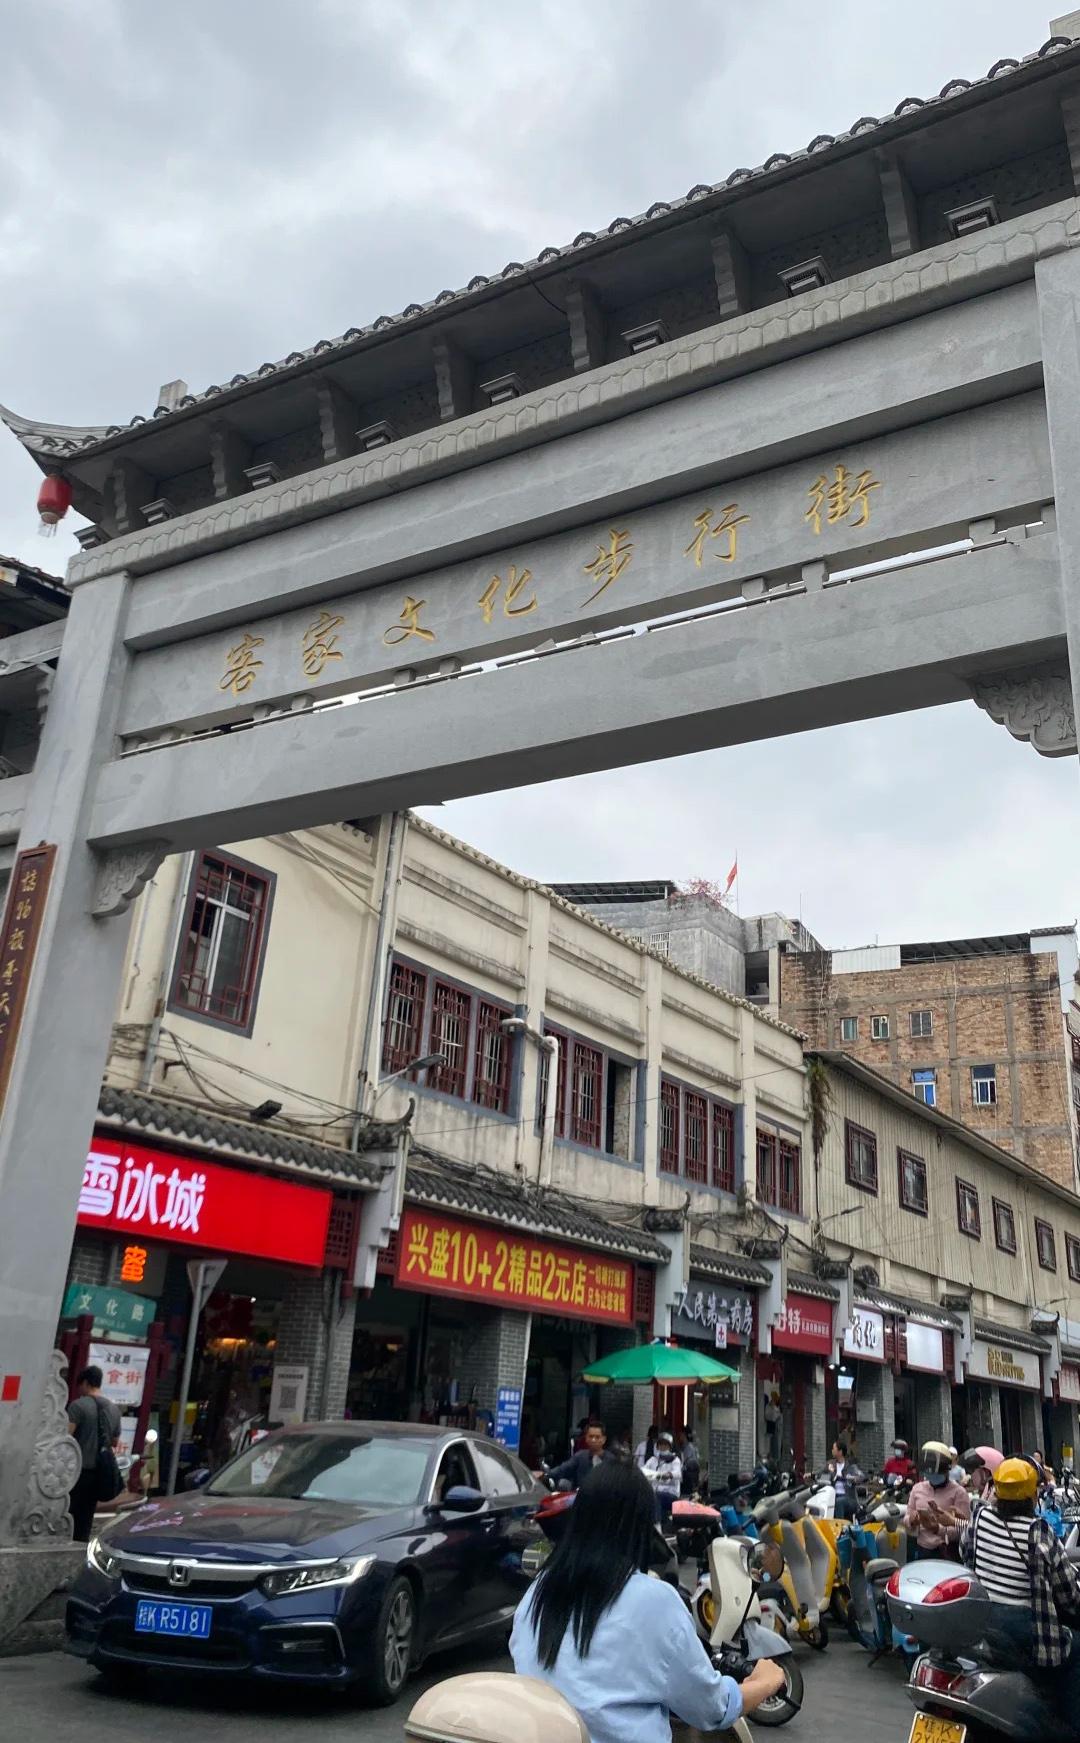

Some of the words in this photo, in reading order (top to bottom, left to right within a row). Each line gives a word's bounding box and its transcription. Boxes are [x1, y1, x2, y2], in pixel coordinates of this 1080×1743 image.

[220, 465, 882, 697] 客家文化步行街
[78, 1151, 206, 1233] 雪冰城
[406, 1223, 587, 1306] 兴盛10+2精品2元店
